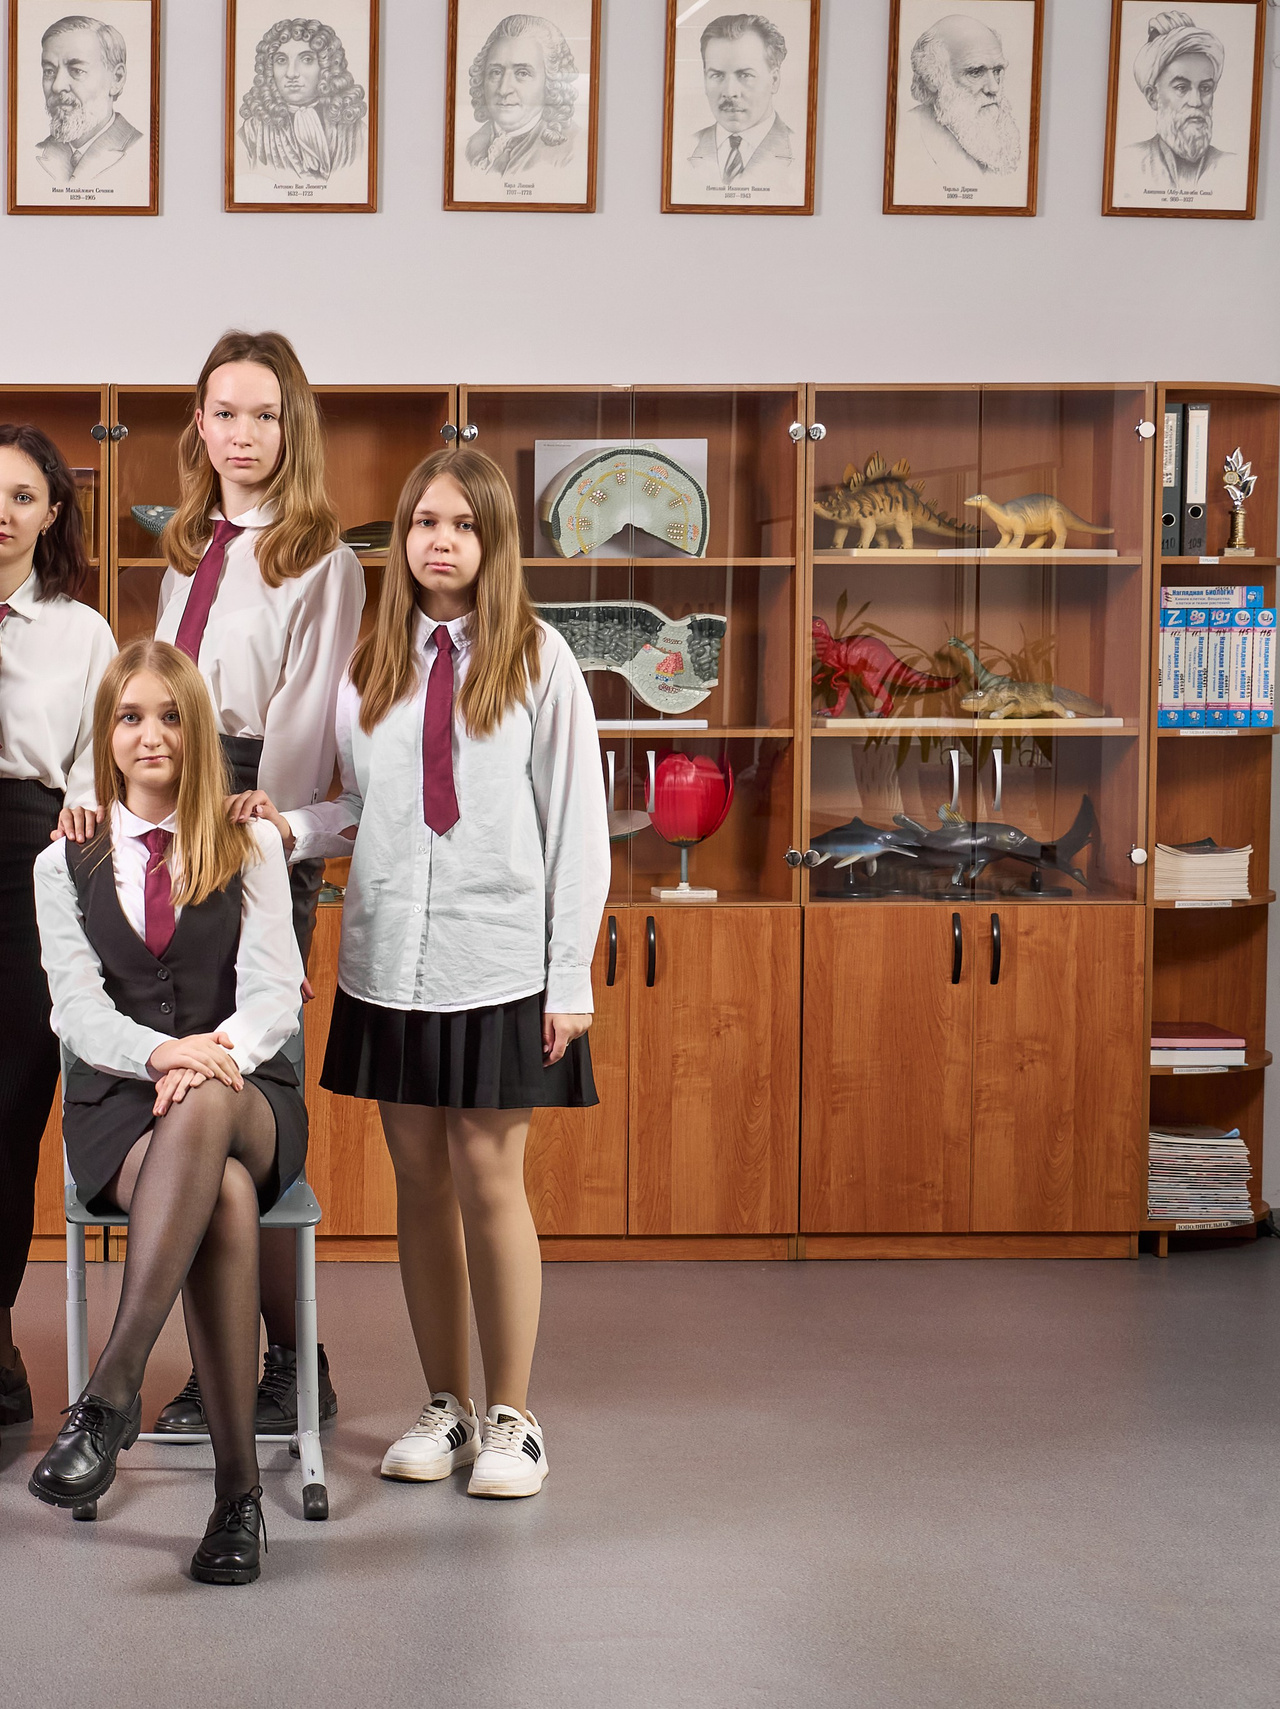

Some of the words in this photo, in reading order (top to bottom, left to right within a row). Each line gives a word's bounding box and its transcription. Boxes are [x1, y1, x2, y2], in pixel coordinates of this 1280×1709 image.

[1172, 589, 1203, 597] Наглядная
[1197, 637, 1205, 668] Наглядная
[1218, 637, 1226, 668] Наглядная
[1240, 637, 1248, 668] Наглядная
[1263, 637, 1271, 668] Наглядная
